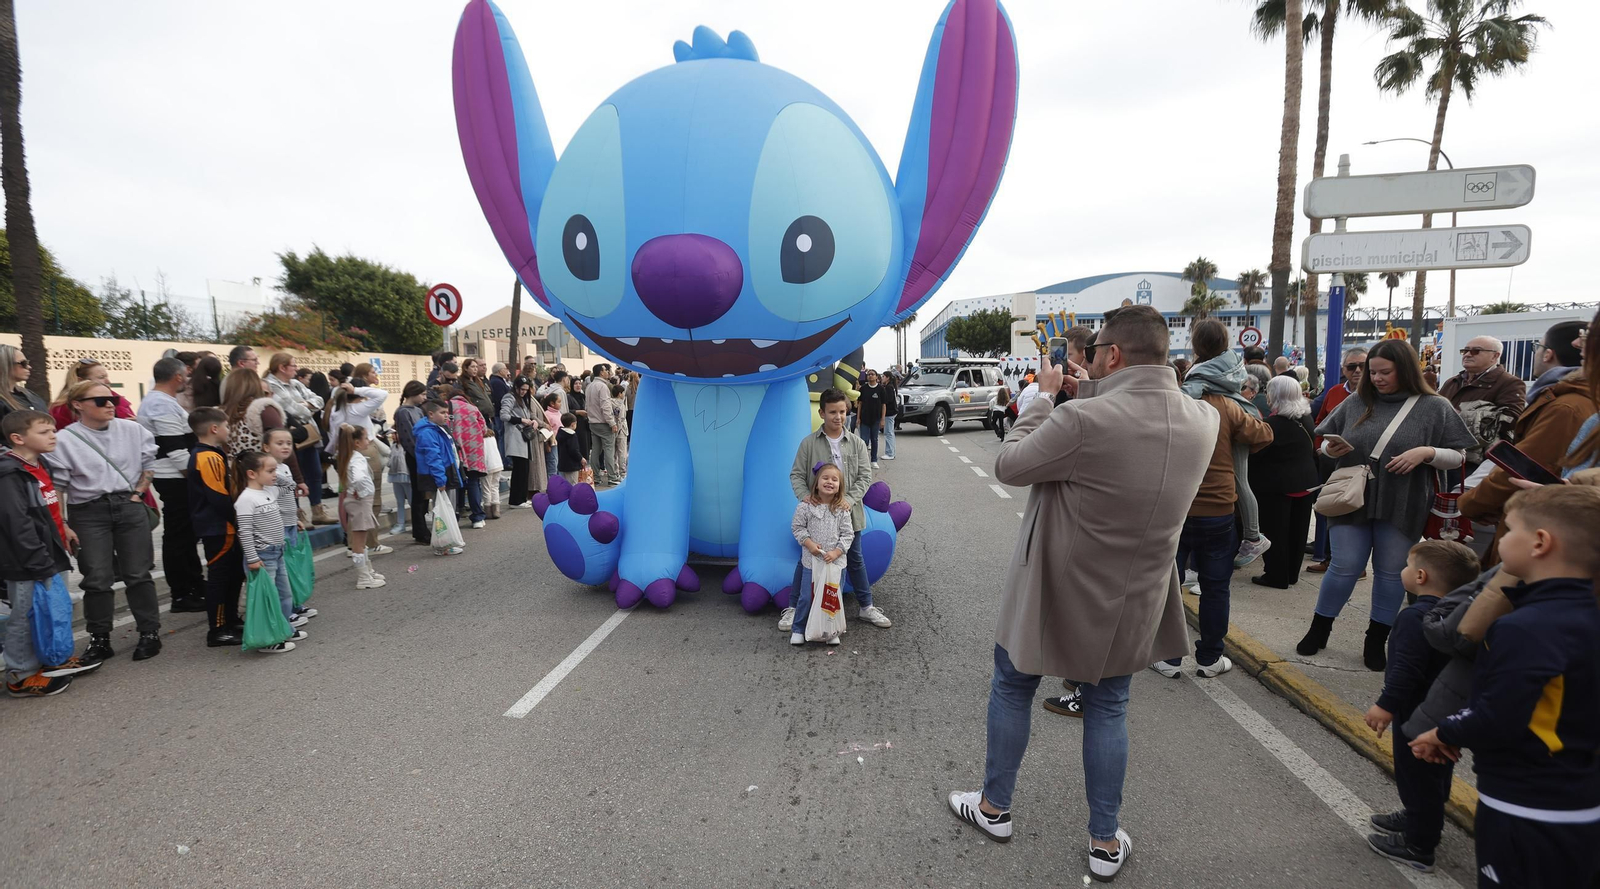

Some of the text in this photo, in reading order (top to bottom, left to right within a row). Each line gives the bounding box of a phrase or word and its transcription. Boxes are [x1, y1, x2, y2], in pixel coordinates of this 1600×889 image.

[1312, 250, 1438, 269] piscina municipal
[482, 325, 550, 339] ESPEANZ
